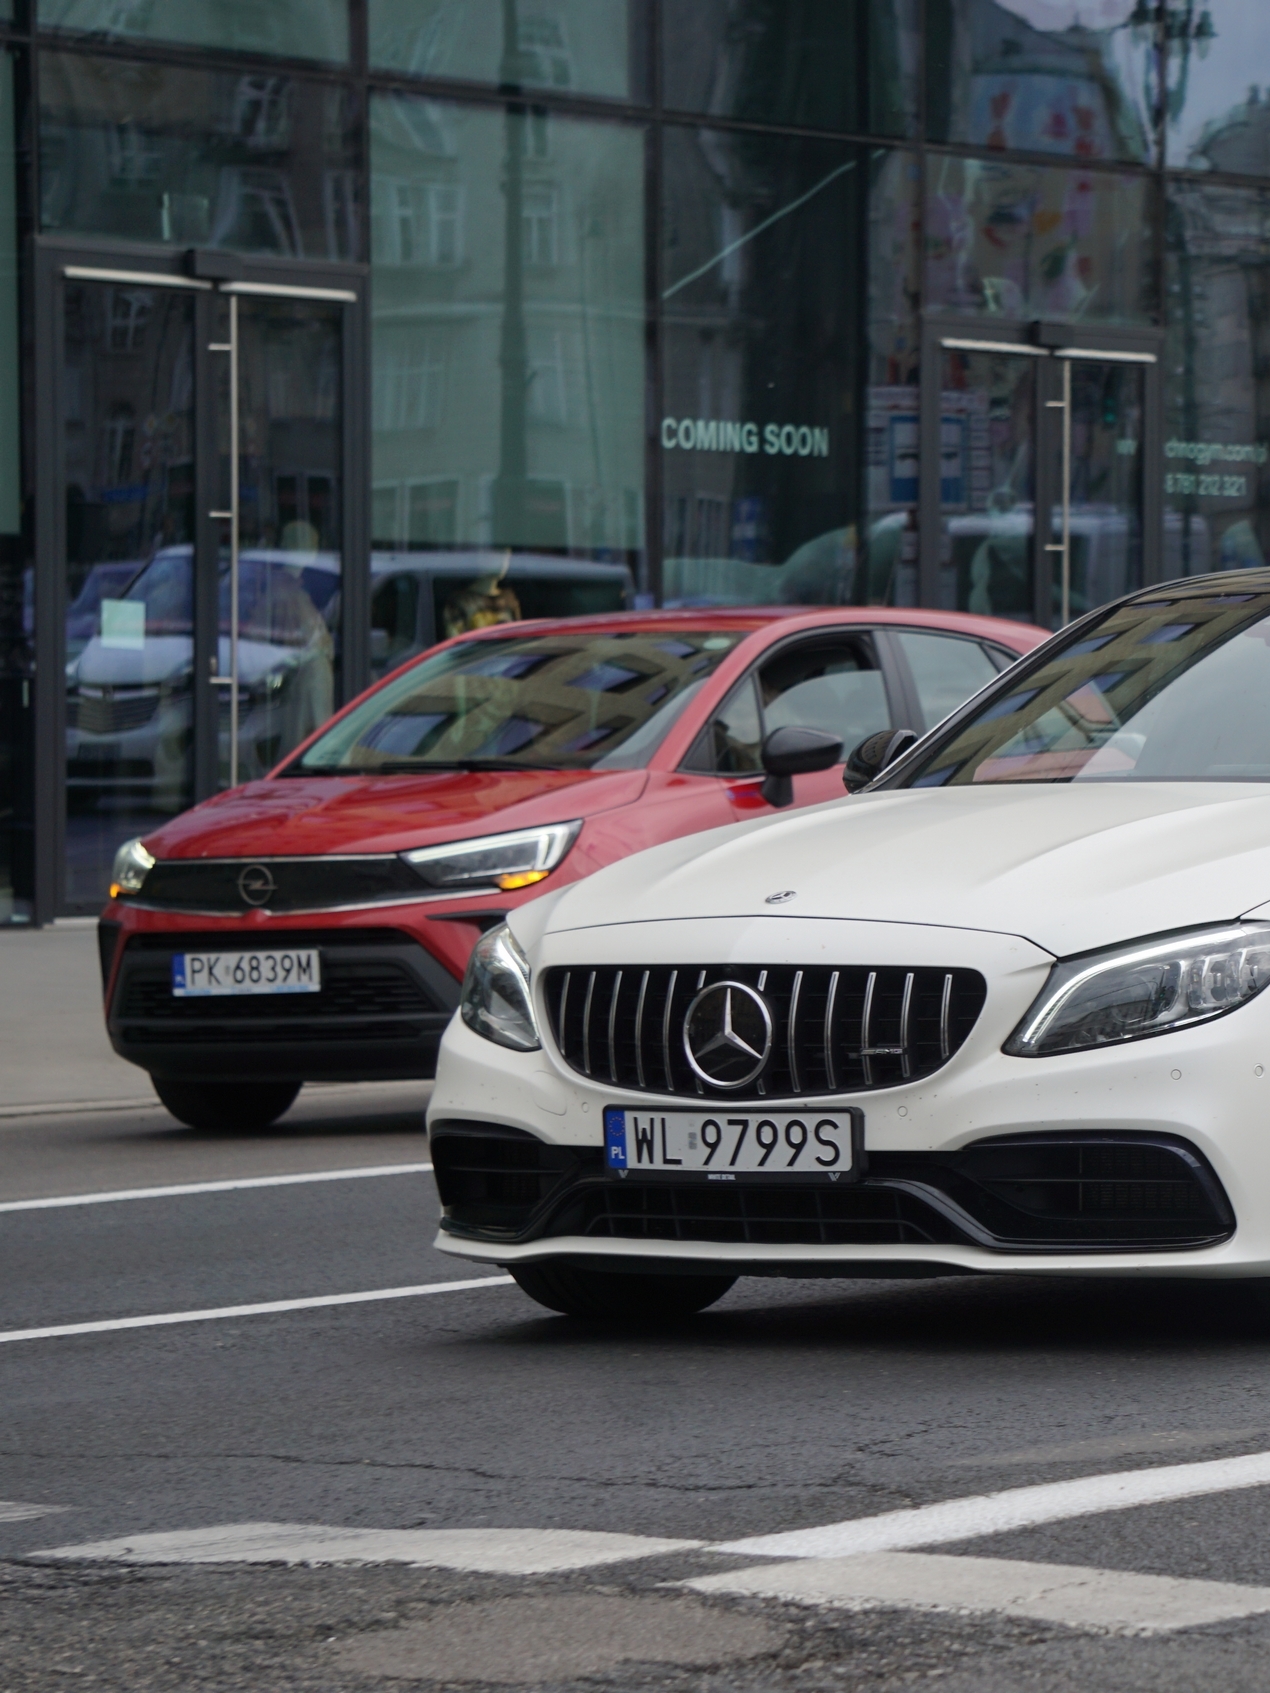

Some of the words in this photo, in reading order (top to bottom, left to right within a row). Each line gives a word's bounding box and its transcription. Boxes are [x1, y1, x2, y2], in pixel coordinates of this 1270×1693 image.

[661, 416, 759, 454] COMING
[763, 422, 830, 458] SOON
[189, 956, 222, 986] PK
[232, 953, 313, 984] 6839M
[611, 1147, 626, 1160] PL
[633, 1116, 683, 1165] WL
[700, 1118, 841, 1167] 9799S
